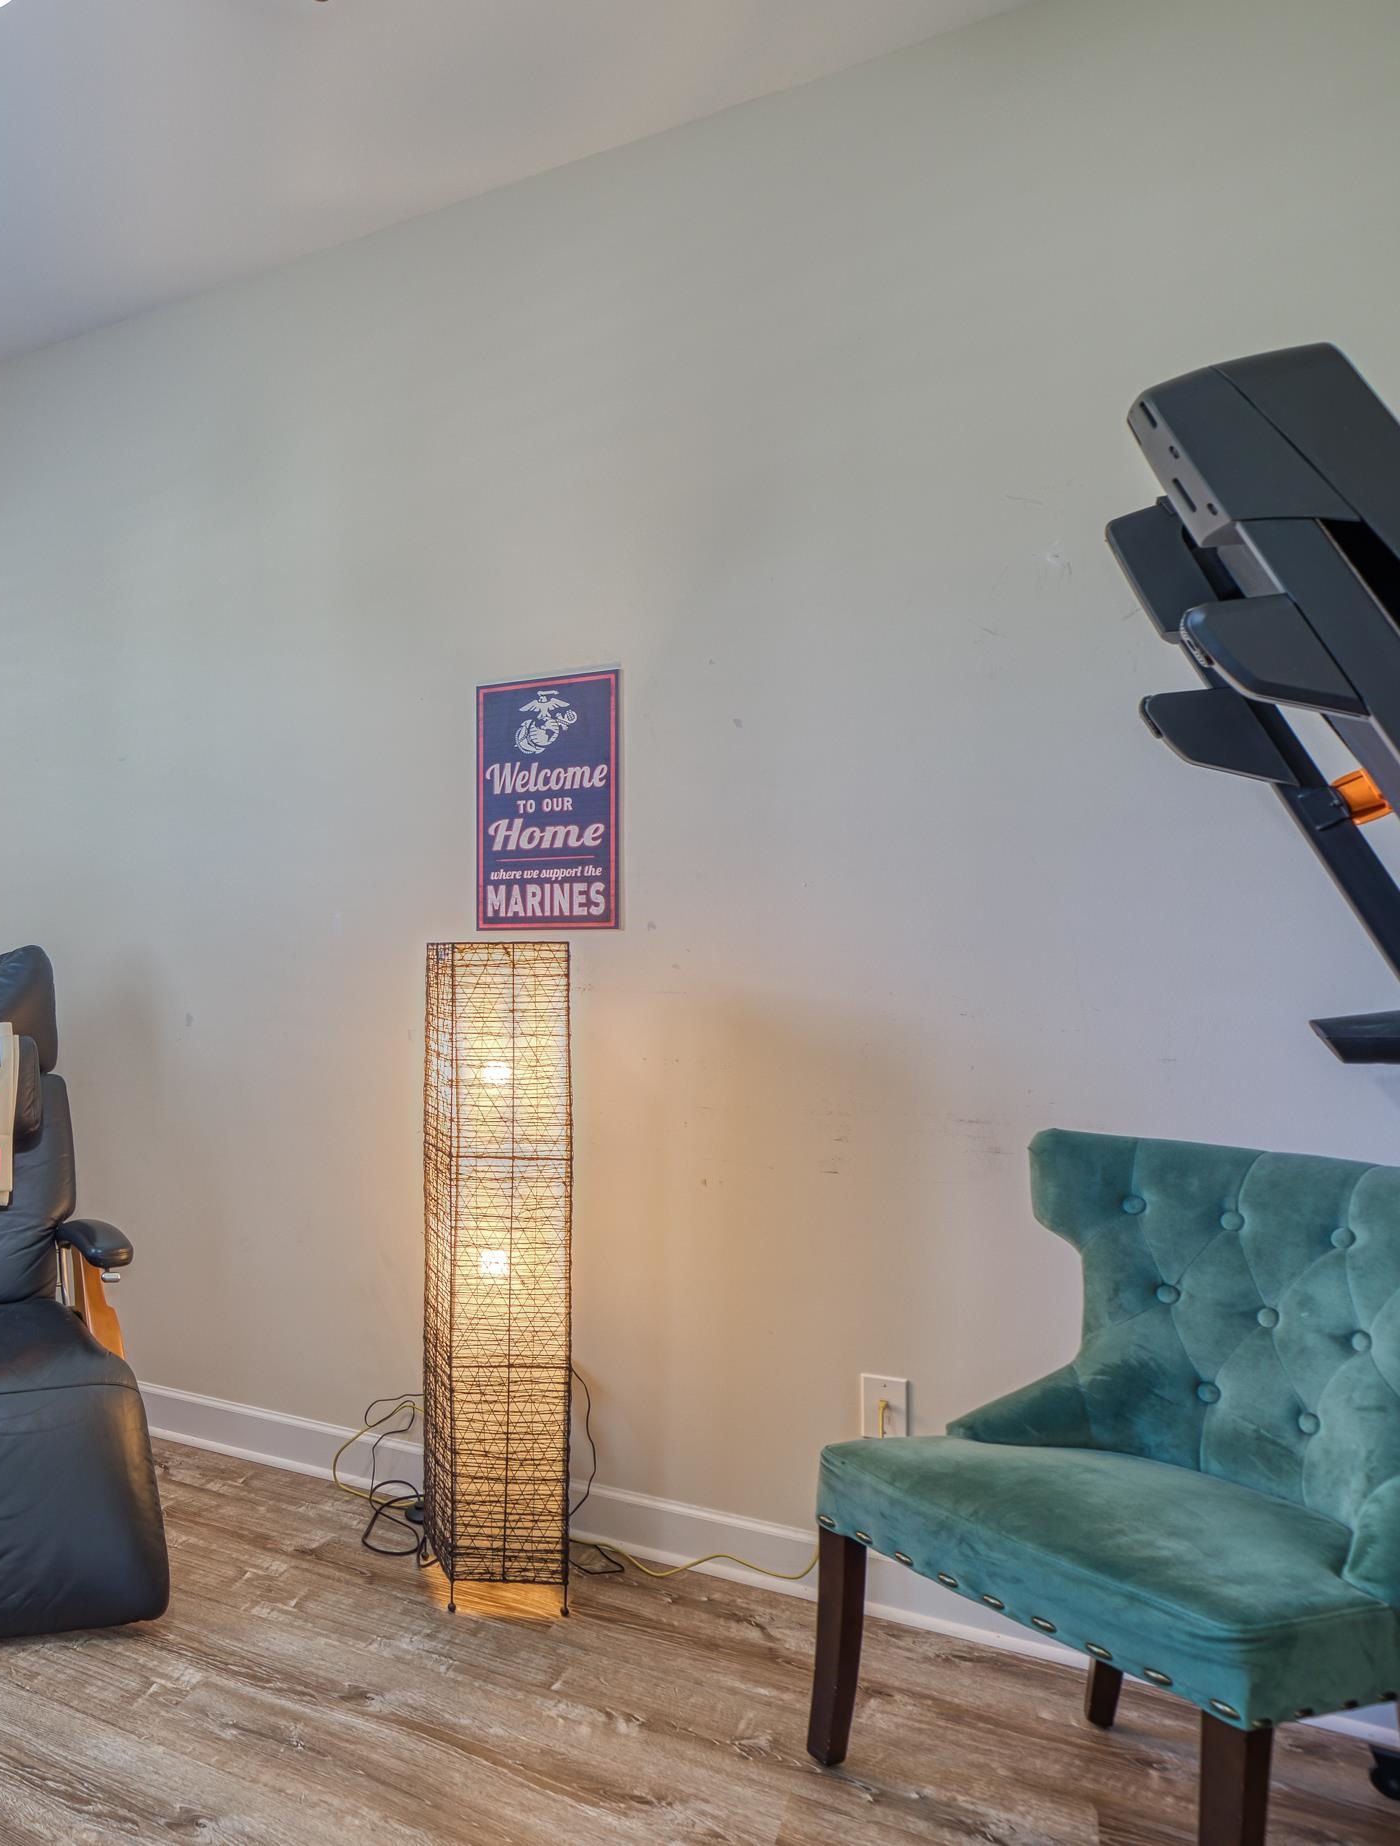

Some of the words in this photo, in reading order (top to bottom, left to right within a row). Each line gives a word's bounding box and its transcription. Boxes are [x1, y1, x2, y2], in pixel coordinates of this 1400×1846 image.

[485, 761, 608, 795] Welcome
[516, 799, 536, 814] TO
[542, 797, 573, 812] OUR
[487, 818, 605, 851] Home
[490, 869, 522, 880] where
[523, 869, 539, 879] we
[540, 866, 581, 881] support
[583, 865, 602, 877] the
[486, 881, 606, 917] MARINES
